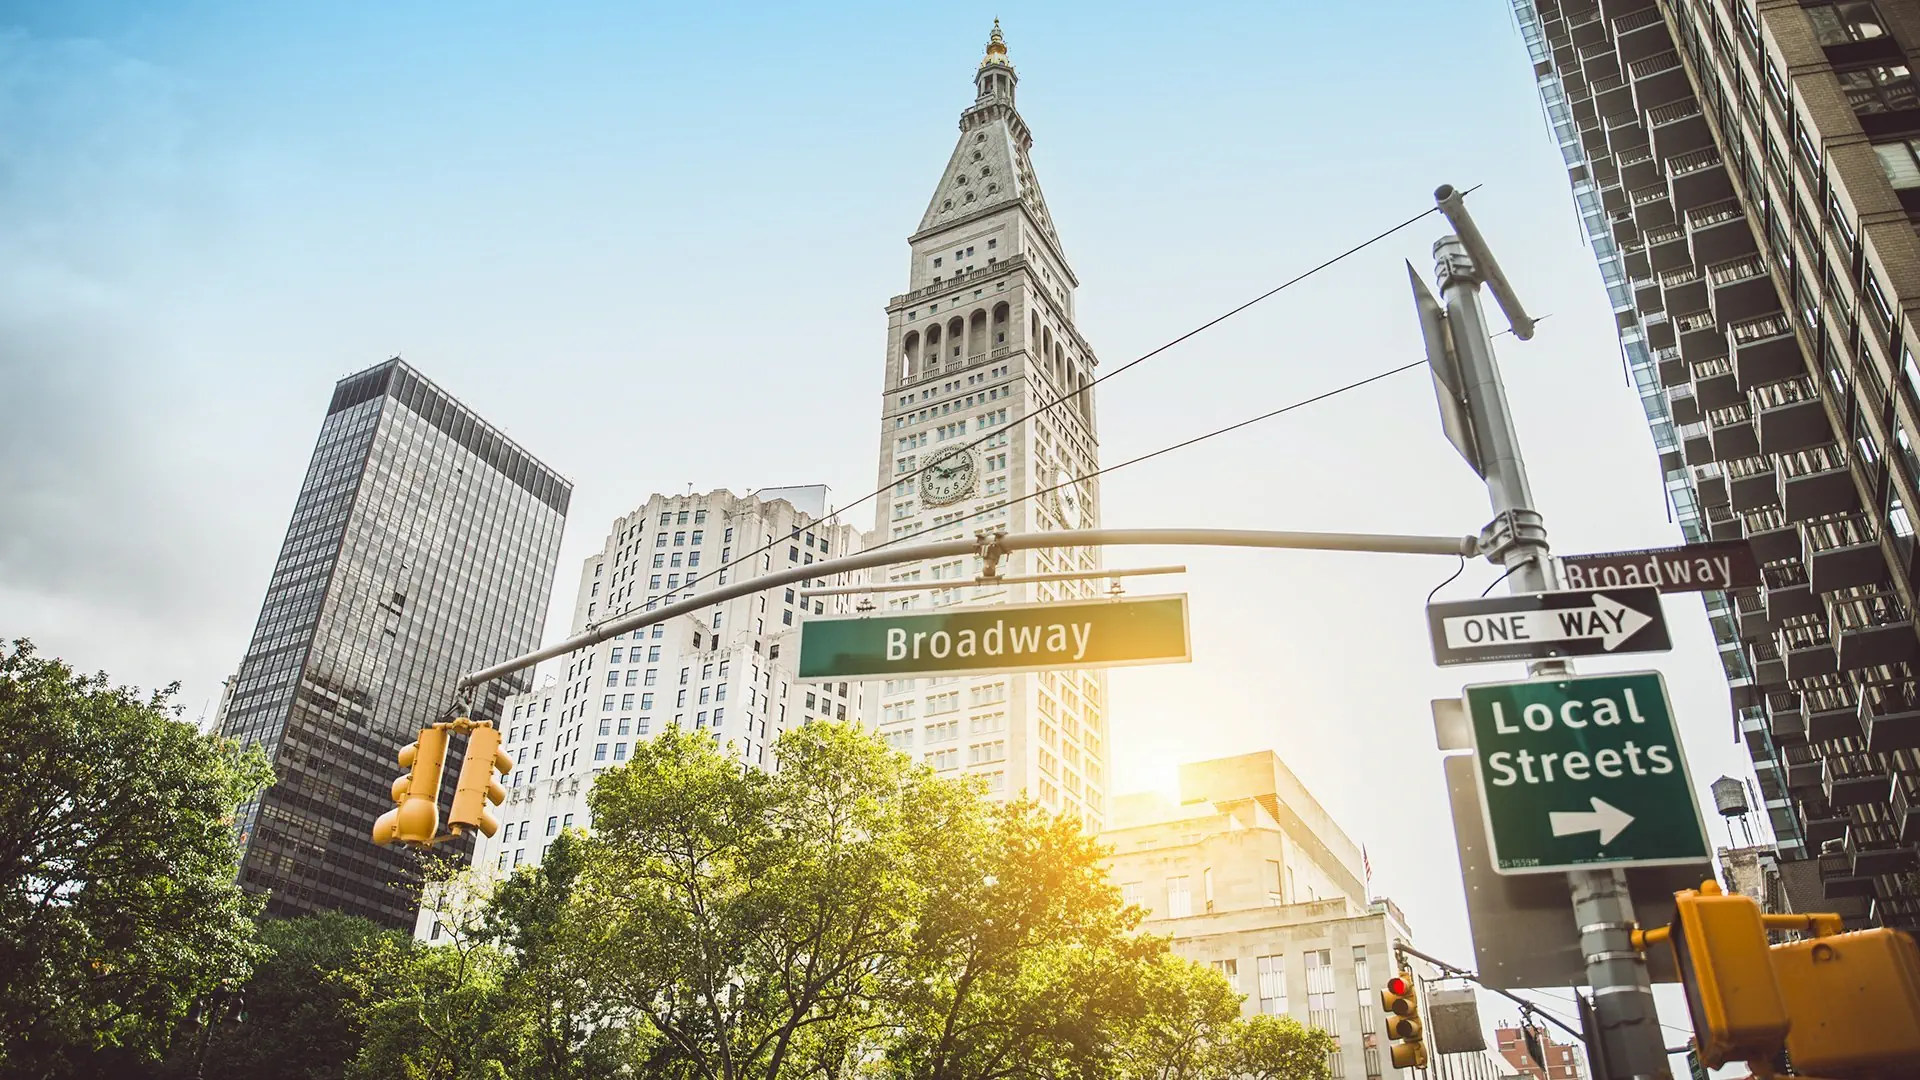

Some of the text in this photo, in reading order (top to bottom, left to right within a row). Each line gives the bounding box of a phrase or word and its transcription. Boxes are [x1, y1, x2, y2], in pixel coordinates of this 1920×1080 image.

[961, 456, 967, 464] 2
[925, 474, 932, 482] 9
[928, 482, 934, 490] 8
[953, 482, 959, 490] 5
[935, 486, 941, 495] 7
[1566, 555, 1732, 588] Broadway
[1463, 608, 1626, 643] ONE WAY
[886, 620, 1092, 661] Broadway
[1491, 688, 1645, 734] Local
[1488, 741, 1675, 787] Streets
